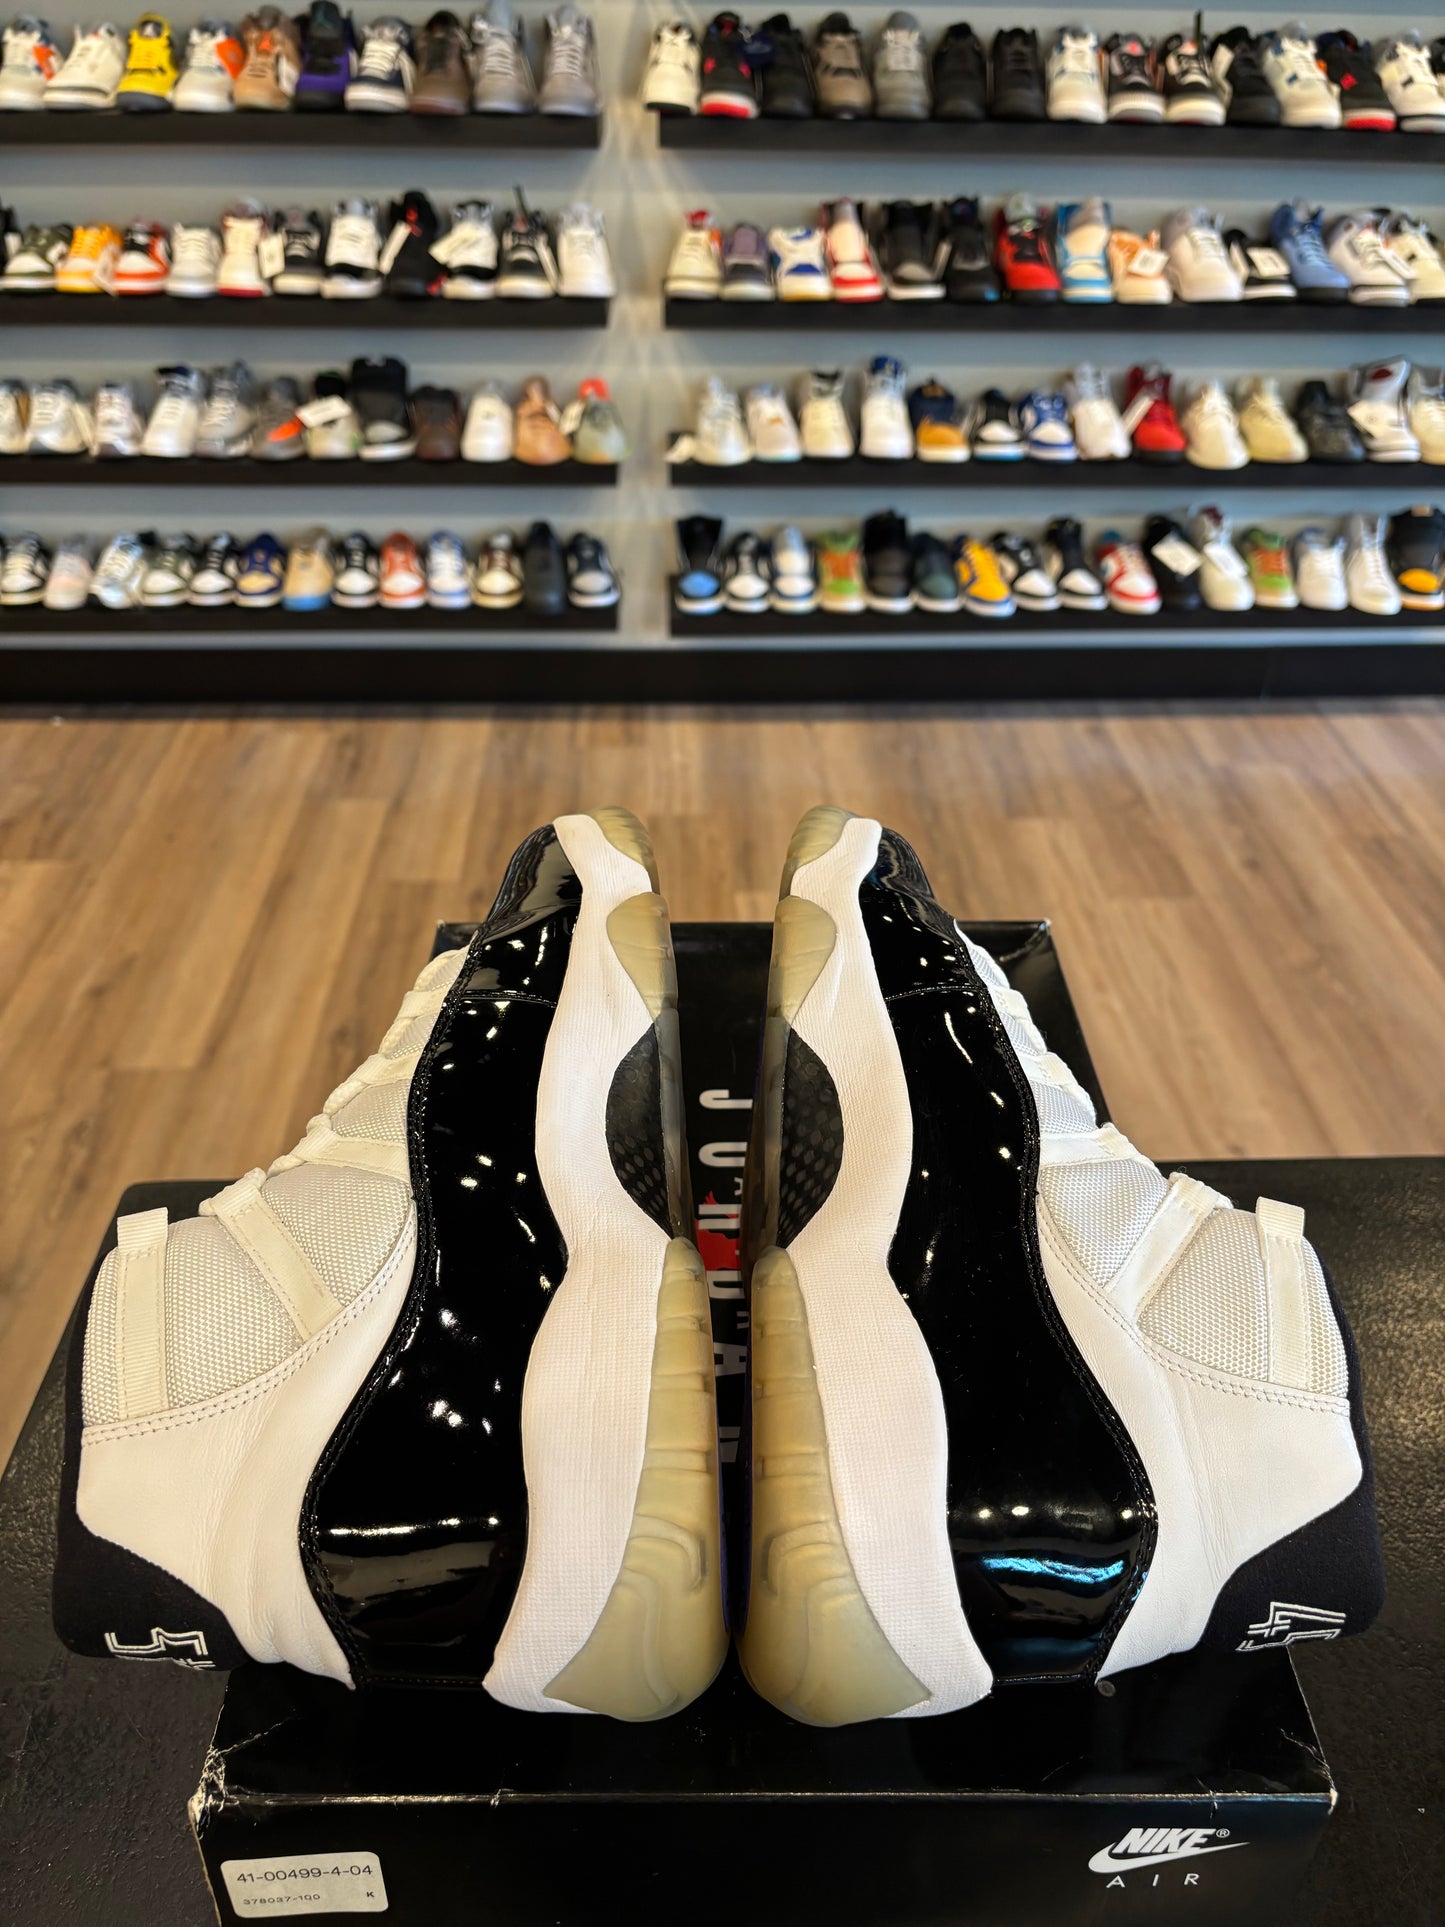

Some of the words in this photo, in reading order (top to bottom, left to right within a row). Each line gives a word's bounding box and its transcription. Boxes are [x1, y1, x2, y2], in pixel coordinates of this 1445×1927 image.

[236, 1864, 373, 1884] 41-00499-4-04
[1106, 1873, 1200, 1889] AIR
[243, 1893, 321, 1906] 378037-100
[366, 1891, 375, 1899] K
